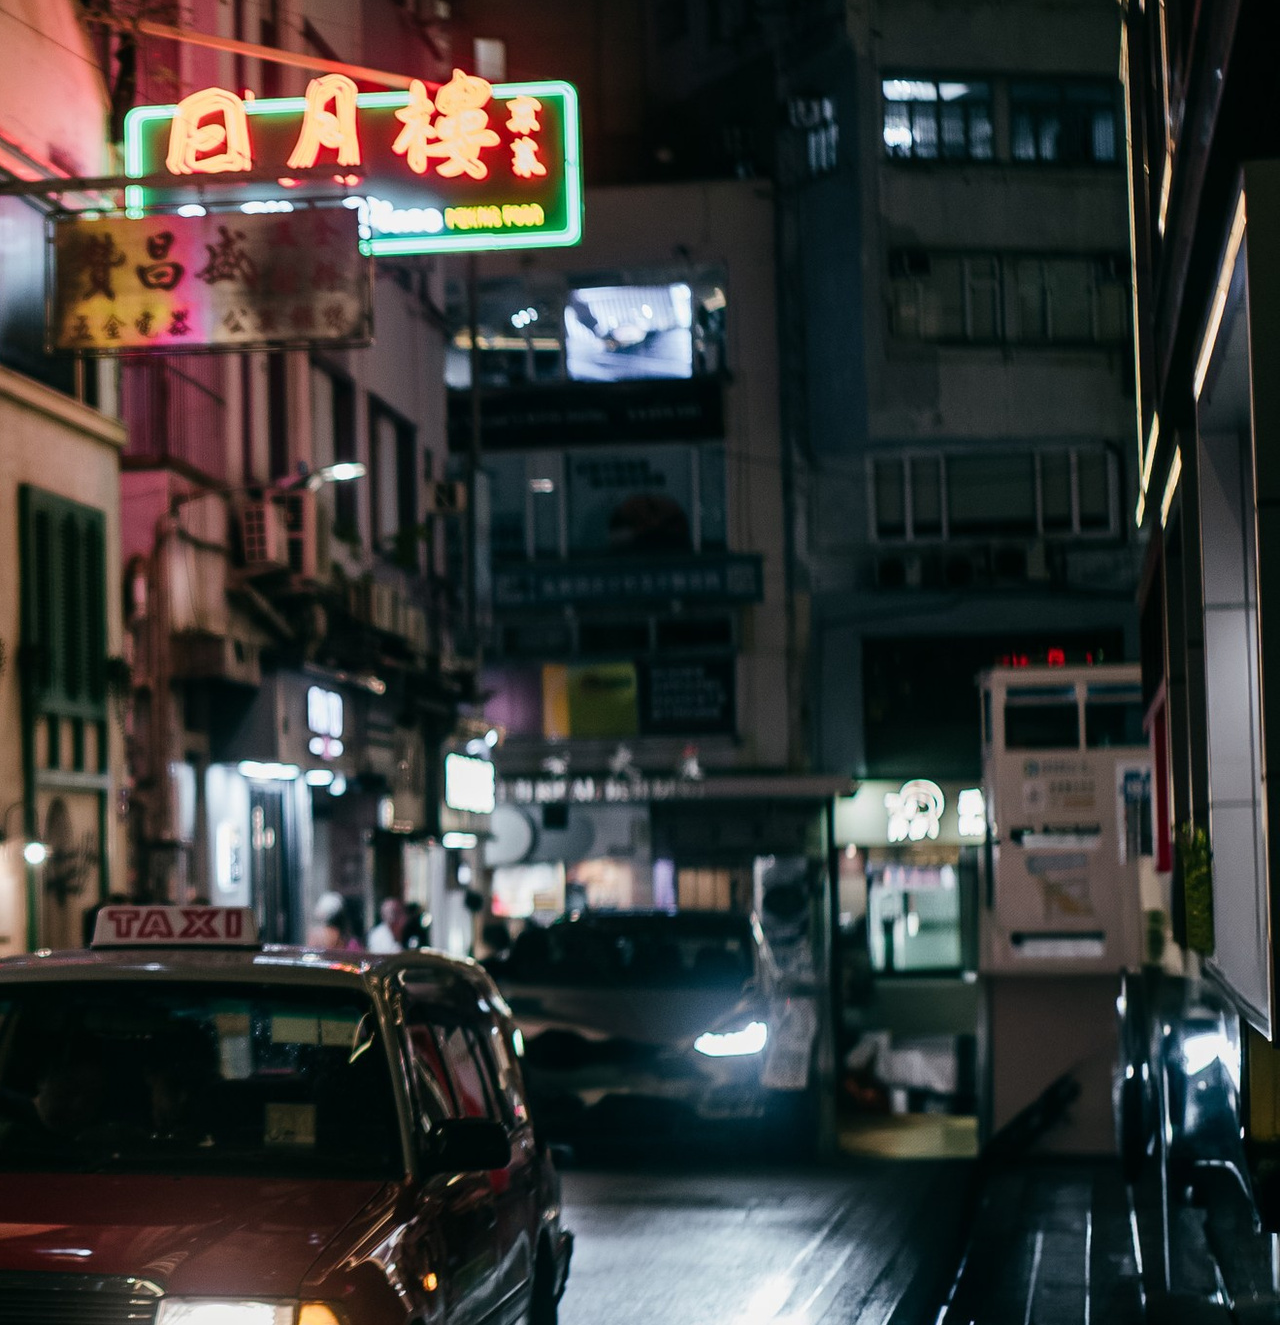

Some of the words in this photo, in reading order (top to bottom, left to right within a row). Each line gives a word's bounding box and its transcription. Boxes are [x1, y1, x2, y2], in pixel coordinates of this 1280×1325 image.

[166, 68, 502, 180] 日月樓
[107, 909, 243, 939] TAXI
